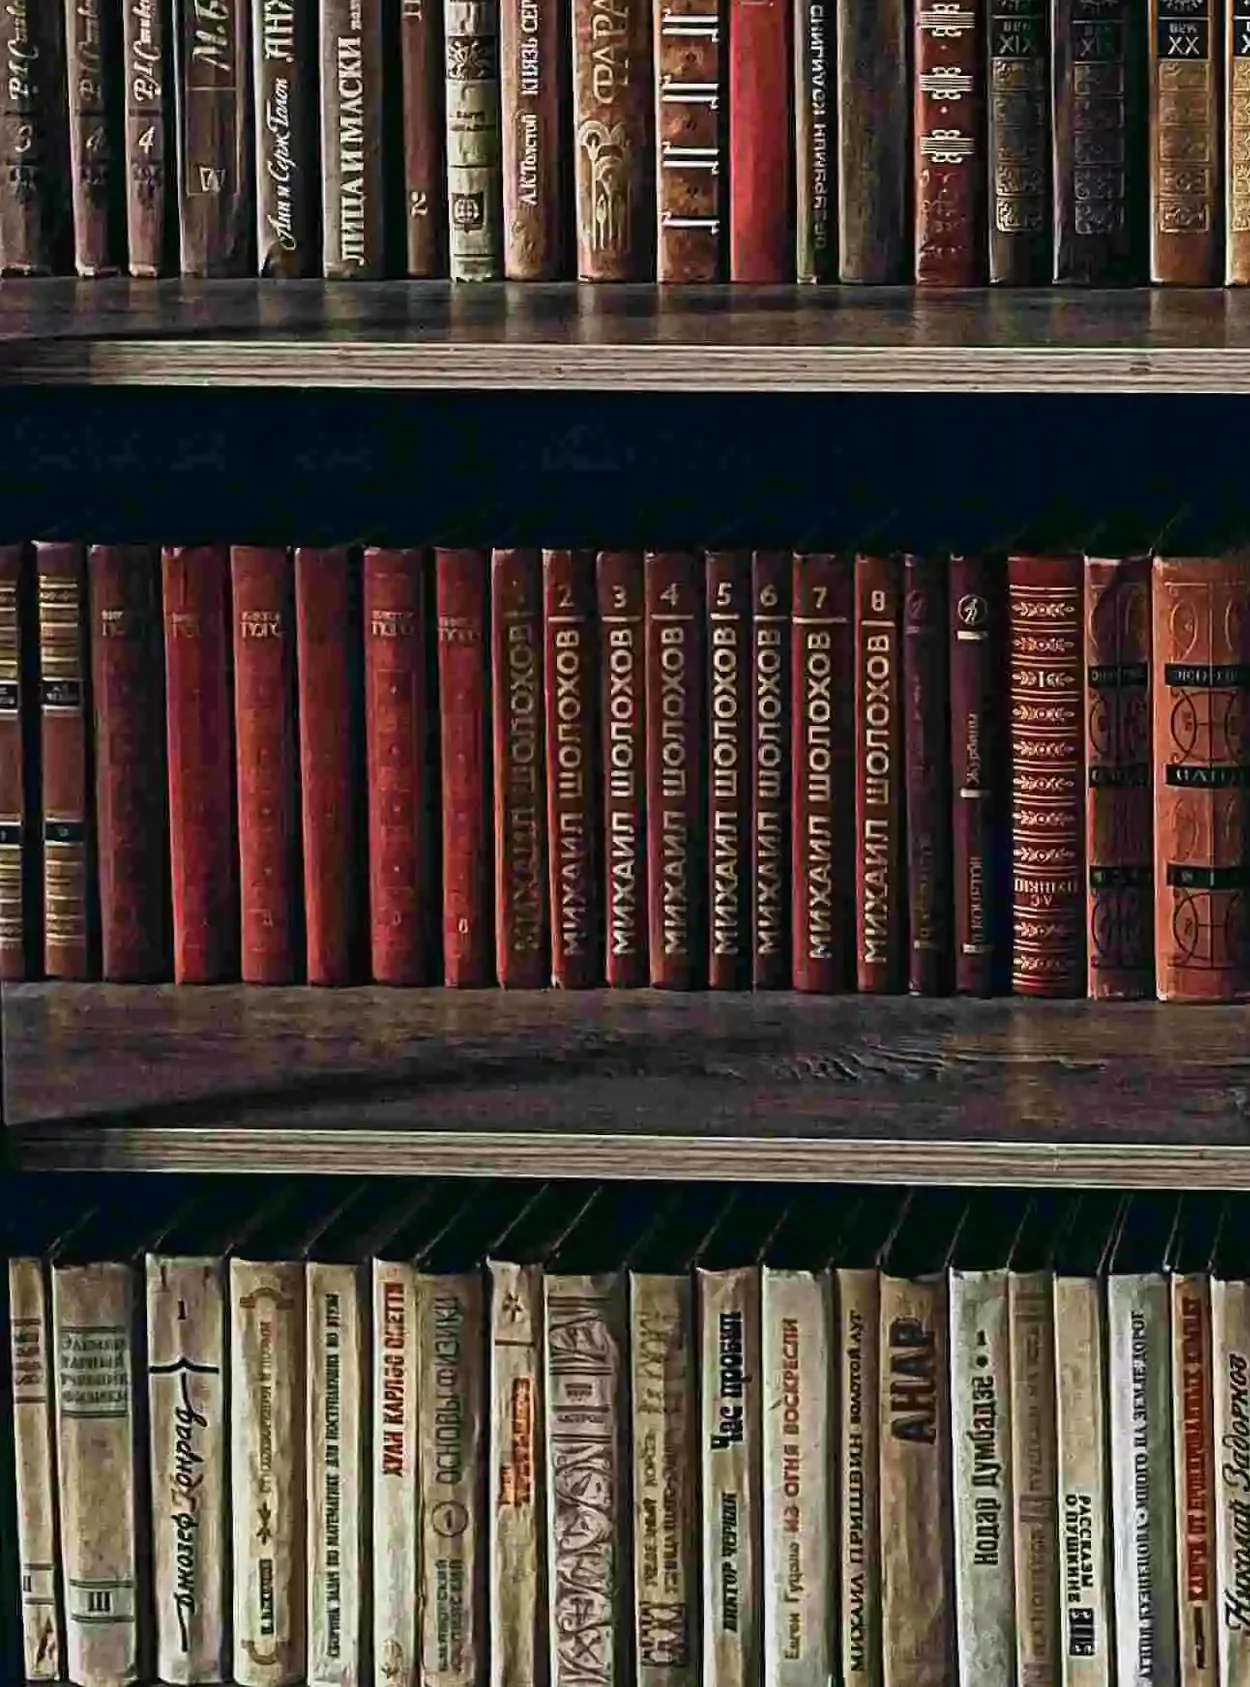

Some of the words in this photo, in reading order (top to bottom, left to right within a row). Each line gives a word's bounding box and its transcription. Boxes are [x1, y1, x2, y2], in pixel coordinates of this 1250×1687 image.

[339, 37, 364, 144] МАСКИ
[520, 37, 540, 95] КНЯЗЬ
[1167, 35, 1201, 55] XX
[267, 132, 296, 184] Серж
[341, 150, 364, 173] И
[341, 179, 366, 265] ЛИЦА
[557, 630, 581, 799] ШОЛОХОВ
[609, 627, 634, 798] ШОЛОХОВ
[660, 627, 686, 798] ШОЛОХОВ
[712, 626, 737, 798] ШОЛОХОВ
[757, 627, 780, 798] ШОЛОХОВ
[807, 631, 831, 802] ШОЛОХОВ
[864, 634, 888, 805] ШОЛОХОВ
[561, 812, 585, 956] МИХАИЛ
[611, 811, 636, 954] МИХАИЛ
[663, 810, 688, 954] МИХАИЛ
[713, 810, 738, 955] МИХАИЛ
[758, 810, 781, 955] МИХАИЛ
[809, 815, 833, 959] МИХАИЛ
[864, 819, 888, 964] МИХАИЛ
[382, 1283, 404, 1348] ОНЕТТИ
[435, 1297, 461, 1386] ФИЗИКИ
[719, 1313, 751, 1398] пробил
[848, 1311, 862, 1343] ЛУГ
[1131, 1311, 1147, 1362] ДОРОГ
[382, 1355, 404, 1425] КАРЛОС
[781, 1319, 800, 1435] ВОСКРЕСЛИ
[847, 1349, 862, 1423] ЗОЛОТОЙ
[890, 1318, 936, 1444] АНАР
[171, 1407, 208, 1510] Конрад
[383, 1431, 404, 1477] ХУАН
[436, 1396, 461, 1484] ОСНОВЫ
[710, 1408, 743, 1450] Час
[783, 1445, 799, 1498] ОГНЯ
[967, 1376, 1000, 1488] Думбадзе
[848, 1434, 866, 1564] ПРИШВИН
[973, 1498, 999, 1566] Нодар
[1066, 1494, 1078, 1504] О
[1078, 1495, 1092, 1588] РАССКАЗЫ
[170, 1514, 197, 1613] Джозеф
[720, 1563, 738, 1633] ВИКТОР
[1066, 1508, 1080, 1603] ПУШКИНЕ
[849, 1574, 866, 1672] МИХАИЛ
